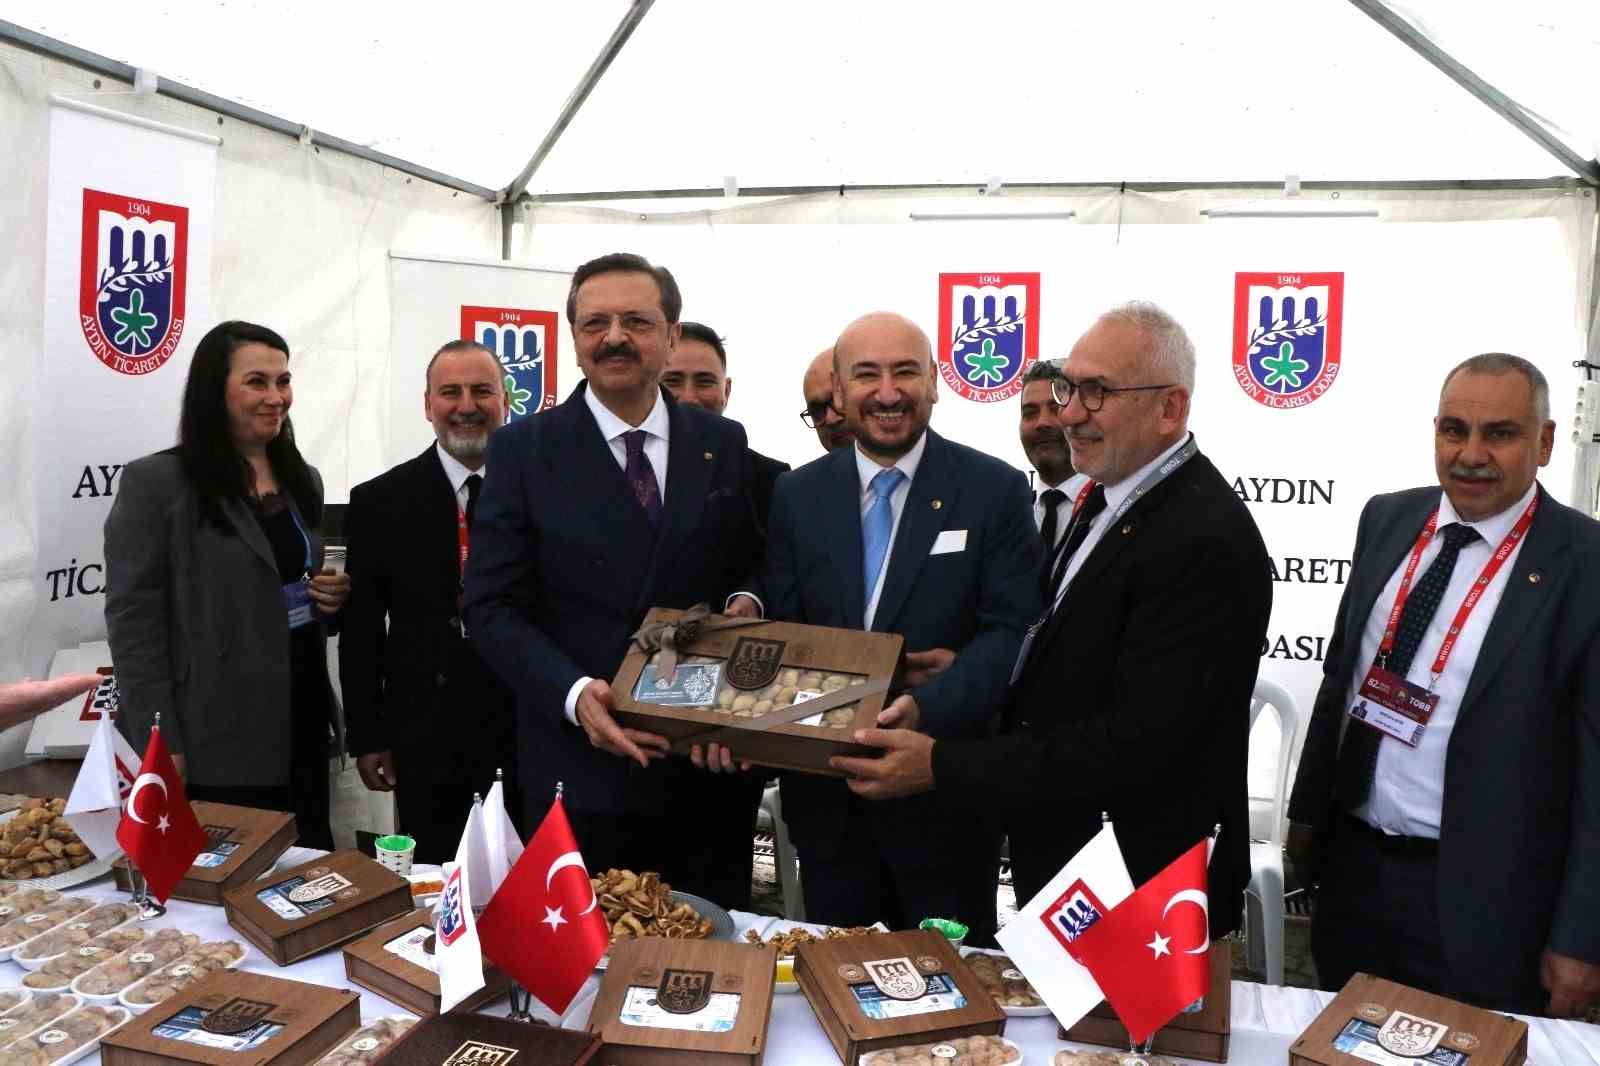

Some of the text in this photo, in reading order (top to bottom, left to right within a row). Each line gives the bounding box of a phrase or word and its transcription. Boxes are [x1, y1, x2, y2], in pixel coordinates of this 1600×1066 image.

[127, 202, 151, 216] 1904
[978, 275, 1001, 284] 1904
[1278, 275, 1301, 285] 1904
[500, 311, 520, 321] 1904
[82, 314, 110, 361] AYDIN
[161, 318, 183, 358] ODASI
[940, 361, 964, 392] AYDIN
[1234, 364, 1262, 398] AYDIN
[1312, 362, 1339, 395] ODASI
[1232, 476, 1335, 504] AYDIN
[1268, 556, 1351, 584] ARET
[1409, 696, 1431, 712] TOBB
